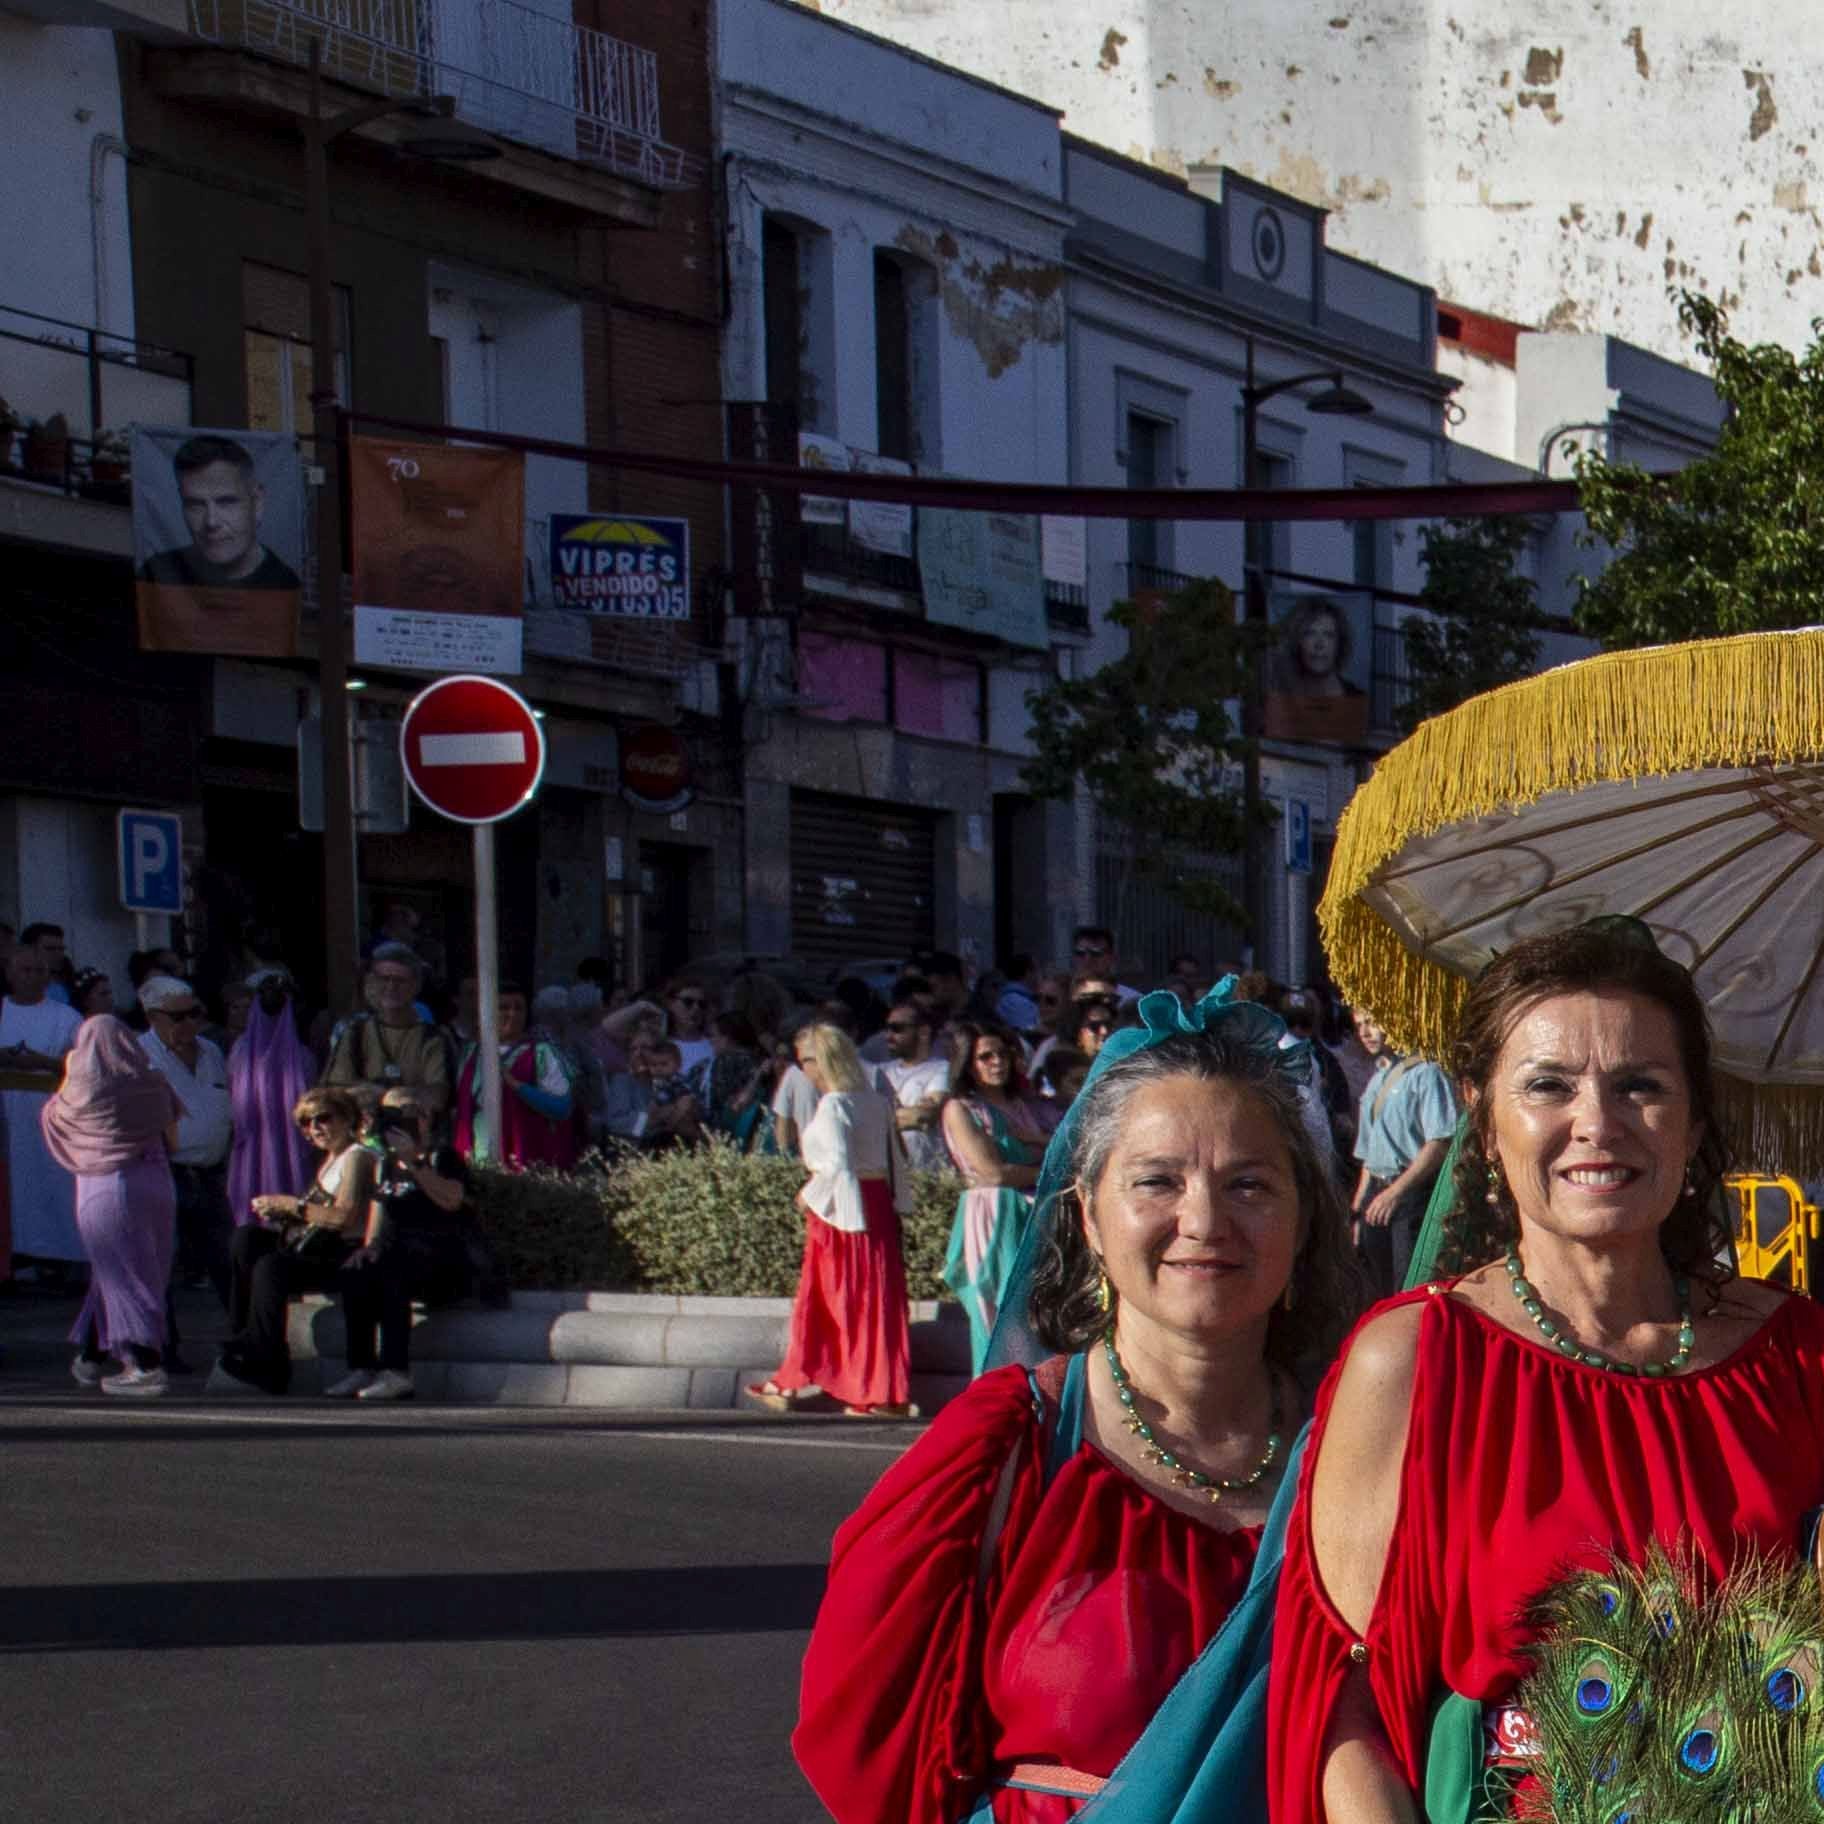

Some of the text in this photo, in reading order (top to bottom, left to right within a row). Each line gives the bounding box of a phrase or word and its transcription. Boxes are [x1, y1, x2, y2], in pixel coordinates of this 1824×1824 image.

[387, 458, 420, 482] 70
[559, 546, 676, 582] VIPRÉS
[564, 575, 659, 597] VENDIDO
[132, 823, 169, 899] P
